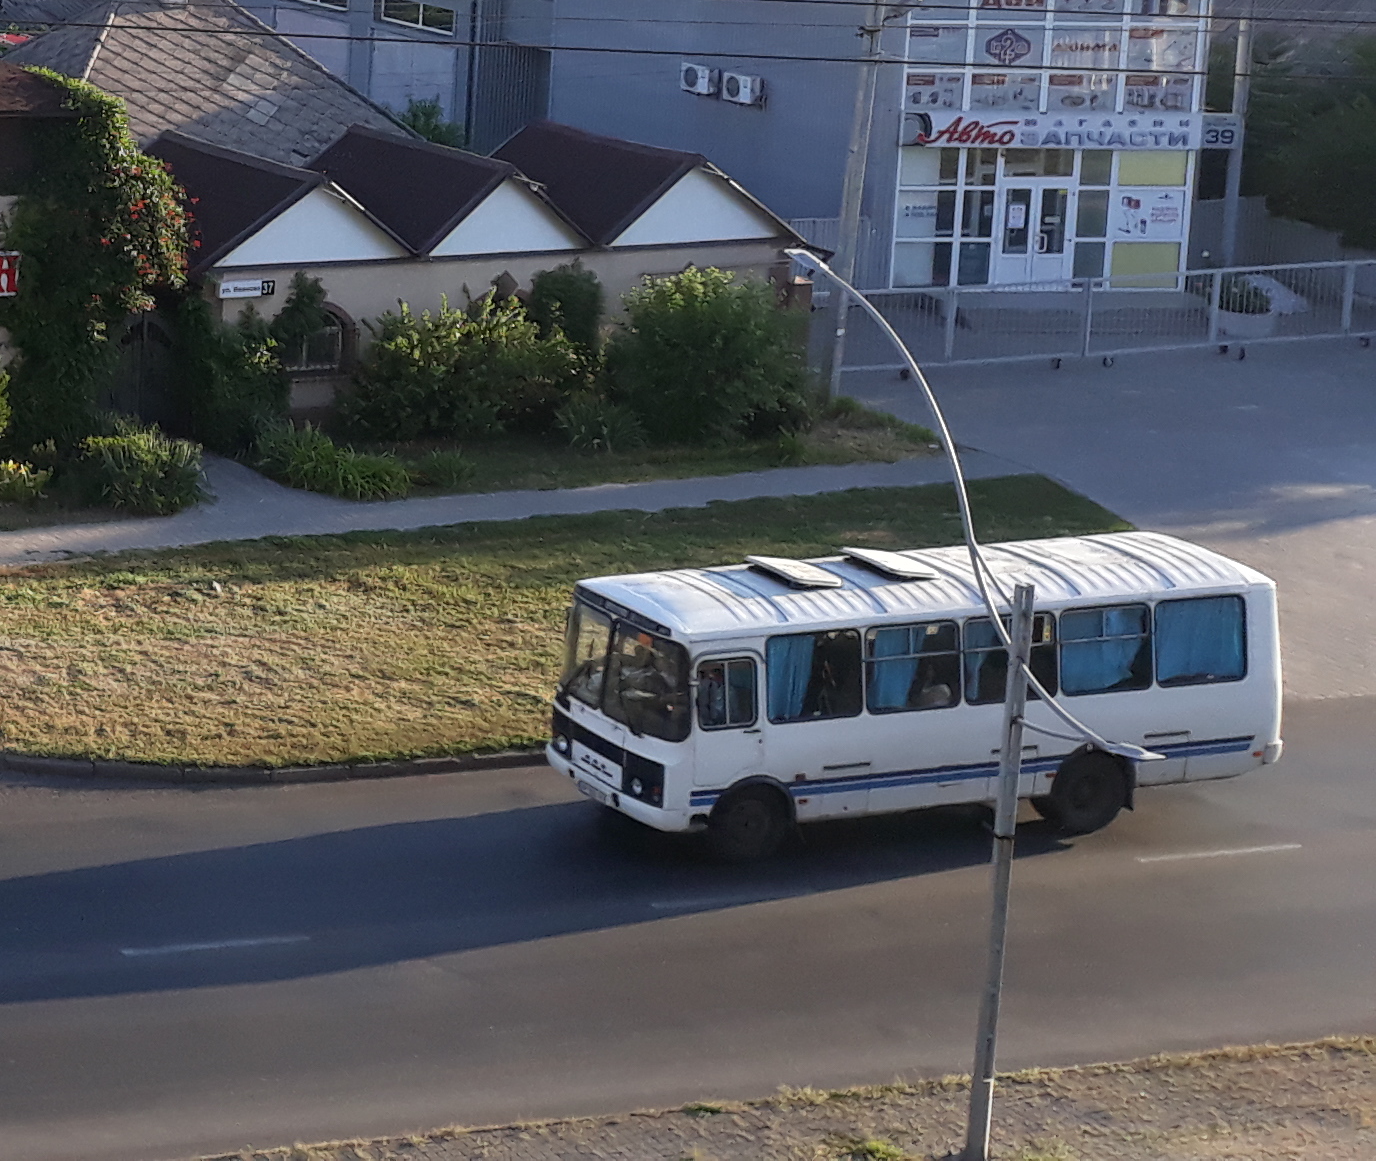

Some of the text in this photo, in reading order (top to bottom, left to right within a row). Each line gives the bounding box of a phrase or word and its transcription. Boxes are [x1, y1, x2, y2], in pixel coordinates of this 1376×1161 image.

[917, 116, 1190, 147] Авто ЗАПЧАСТИ
[1205, 129, 1235, 144] 39
[262, 281, 274, 294] 37
